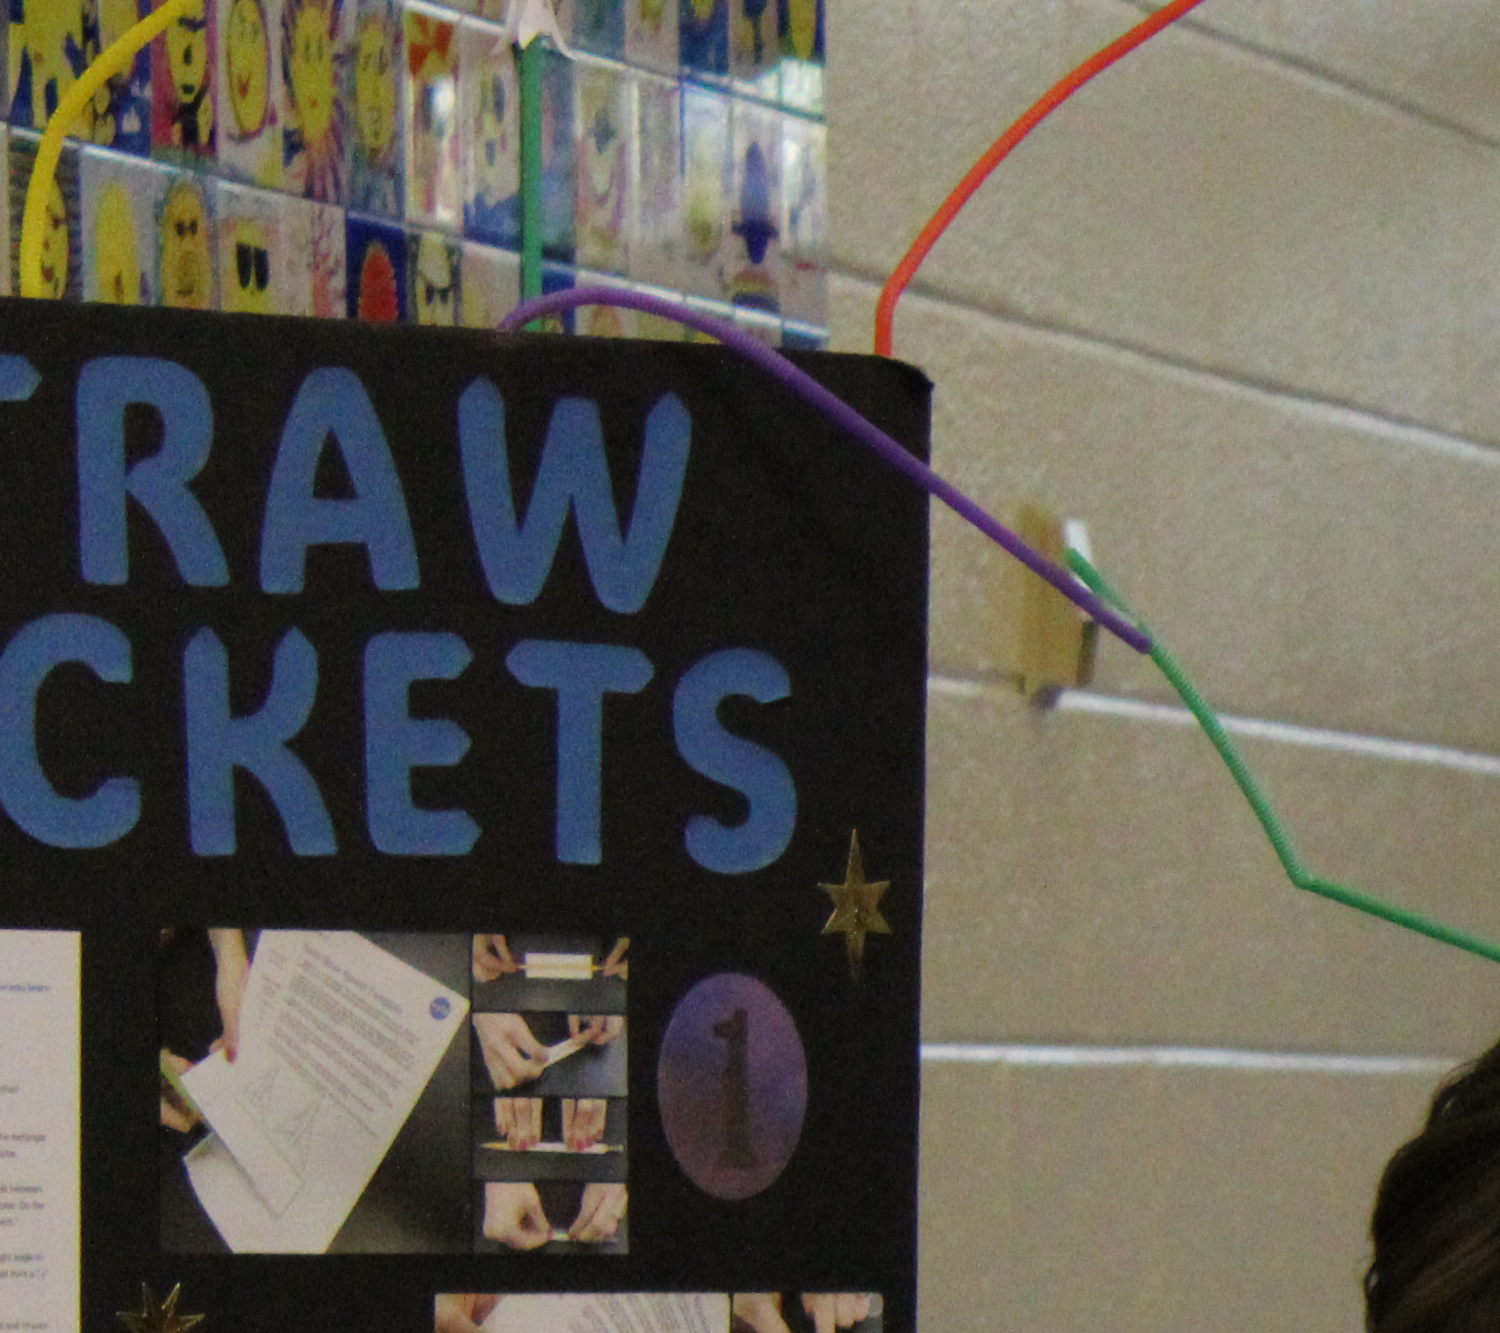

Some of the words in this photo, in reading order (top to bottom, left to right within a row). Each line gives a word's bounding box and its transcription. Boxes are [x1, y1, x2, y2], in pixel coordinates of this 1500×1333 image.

[0, 354, 692, 614] RAW
[0, 612, 798, 873] CKETS
[712, 1007, 757, 1168] 1
